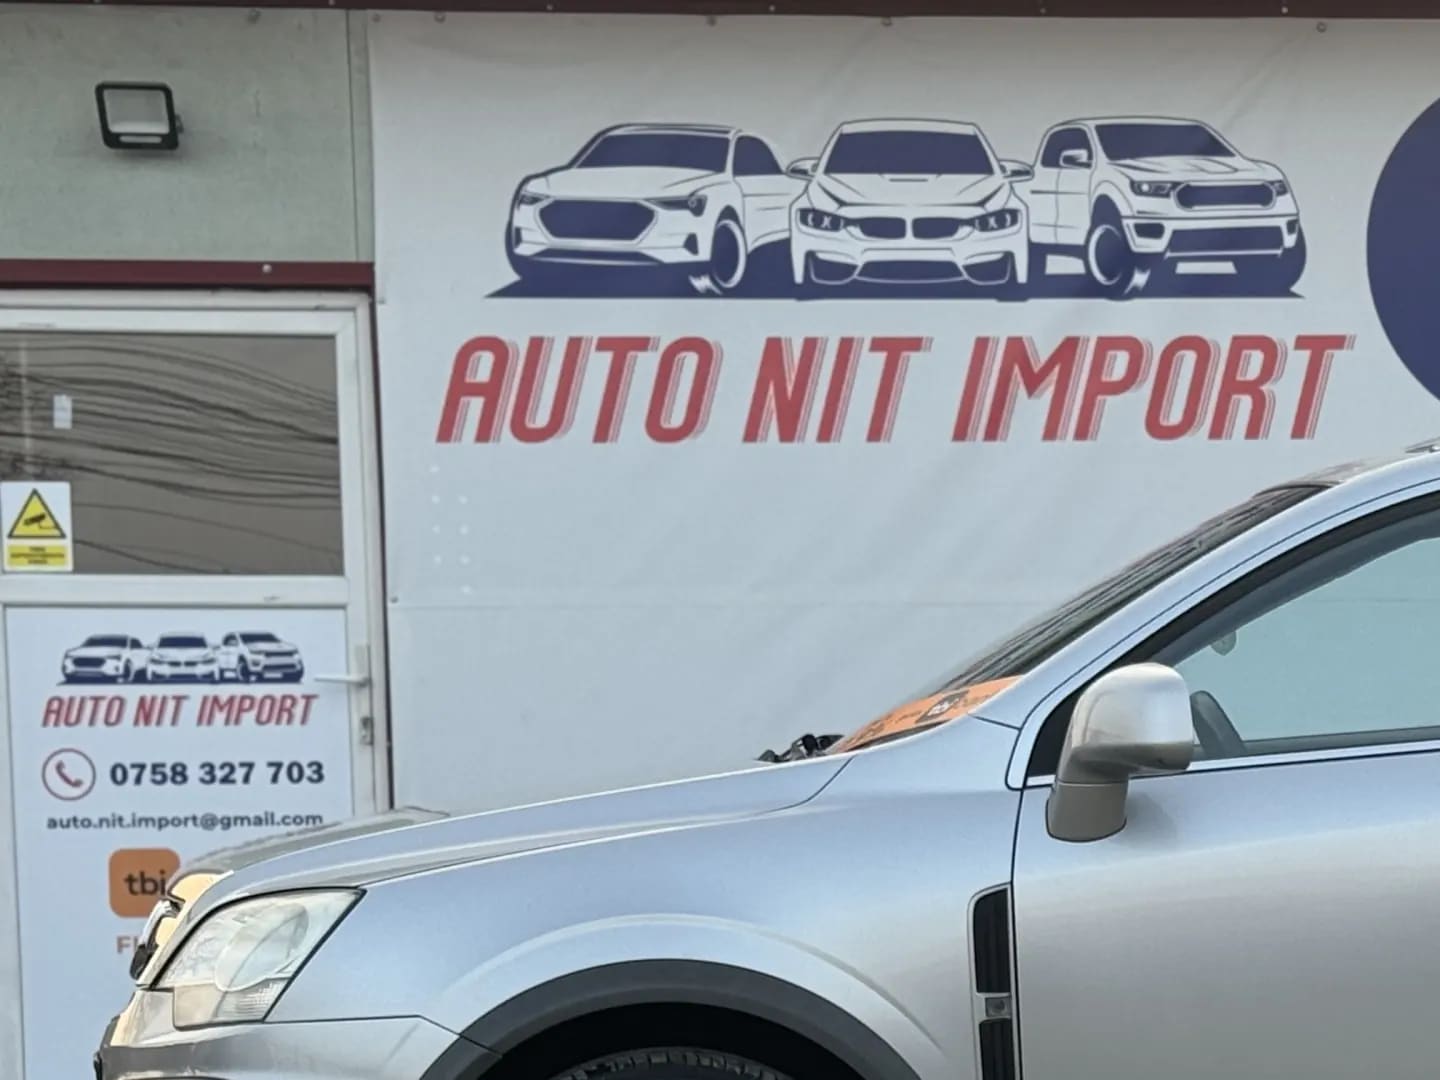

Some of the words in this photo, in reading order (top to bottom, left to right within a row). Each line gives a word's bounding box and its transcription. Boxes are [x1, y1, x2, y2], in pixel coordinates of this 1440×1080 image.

[436, 335, 722, 444] AUTO
[743, 335, 932, 444] NIT
[951, 333, 1355, 442] IMPORT
[41, 695, 126, 728] AUTO
[133, 694, 189, 727] NIT
[196, 693, 319, 727] IMPORT
[109, 762, 189, 786] 0758
[199, 761, 256, 785] 327
[266, 760, 325, 784] 703
[47, 811, 323, 832] auto.nit.import@gmail.com
[124, 869, 167, 896] tbi
